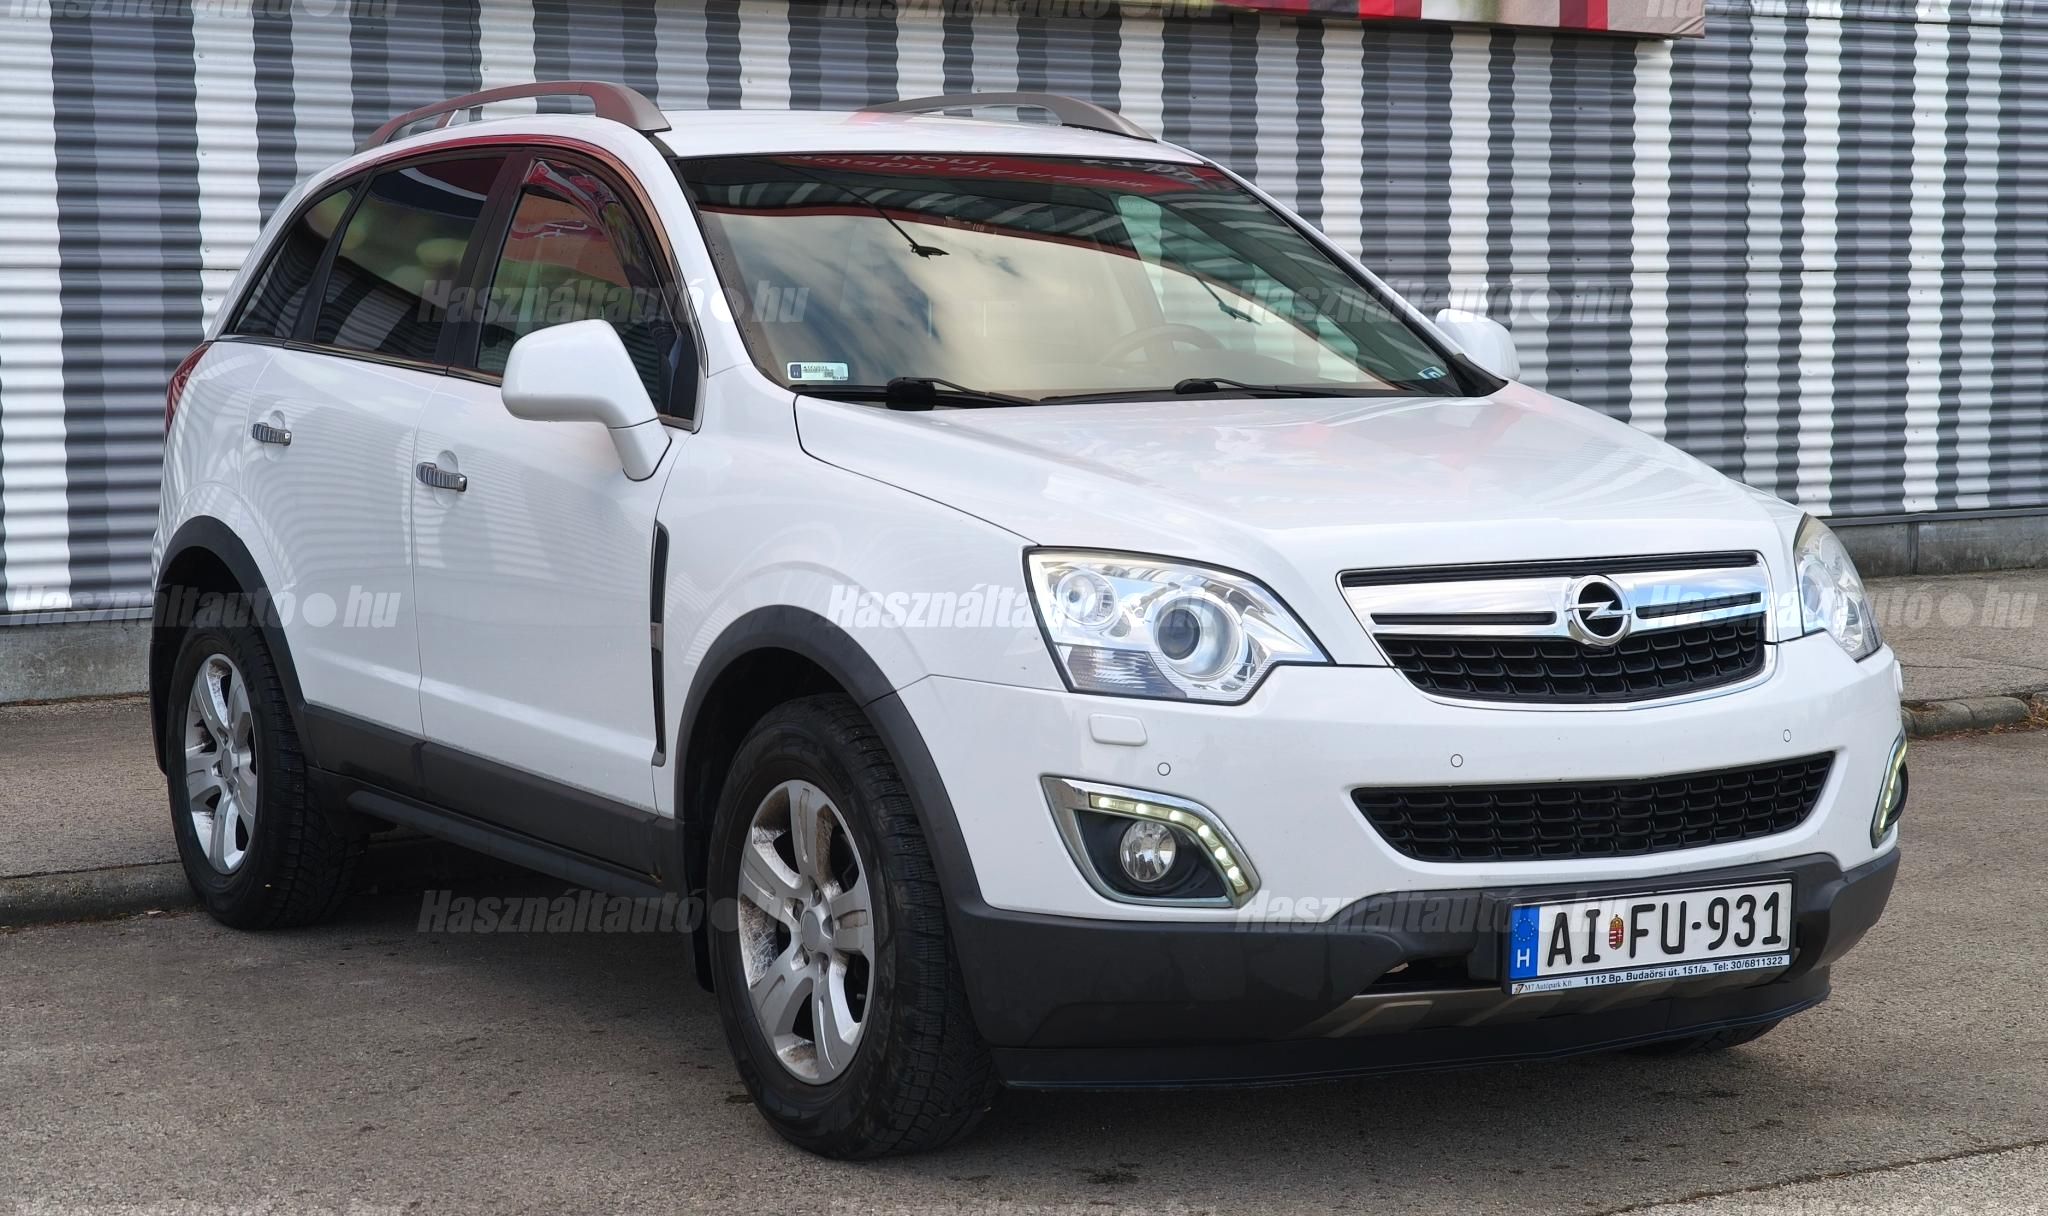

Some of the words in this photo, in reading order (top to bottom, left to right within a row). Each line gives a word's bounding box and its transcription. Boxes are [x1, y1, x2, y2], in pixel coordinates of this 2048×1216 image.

[1547, 909, 1601, 967] AI
[1629, 892, 1782, 959] FU-931
[1516, 948, 1530, 968] H
[1584, 975, 1606, 985] 1112
[1608, 974, 1624, 983] Bp.
[1626, 969, 1666, 981] Budaörsi
[1668, 967, 1680, 977] út.
[1683, 965, 1709, 975] 151/a.
[1713, 962, 1729, 972] Tel:
[1731, 957, 1783, 969] 30/6811322
